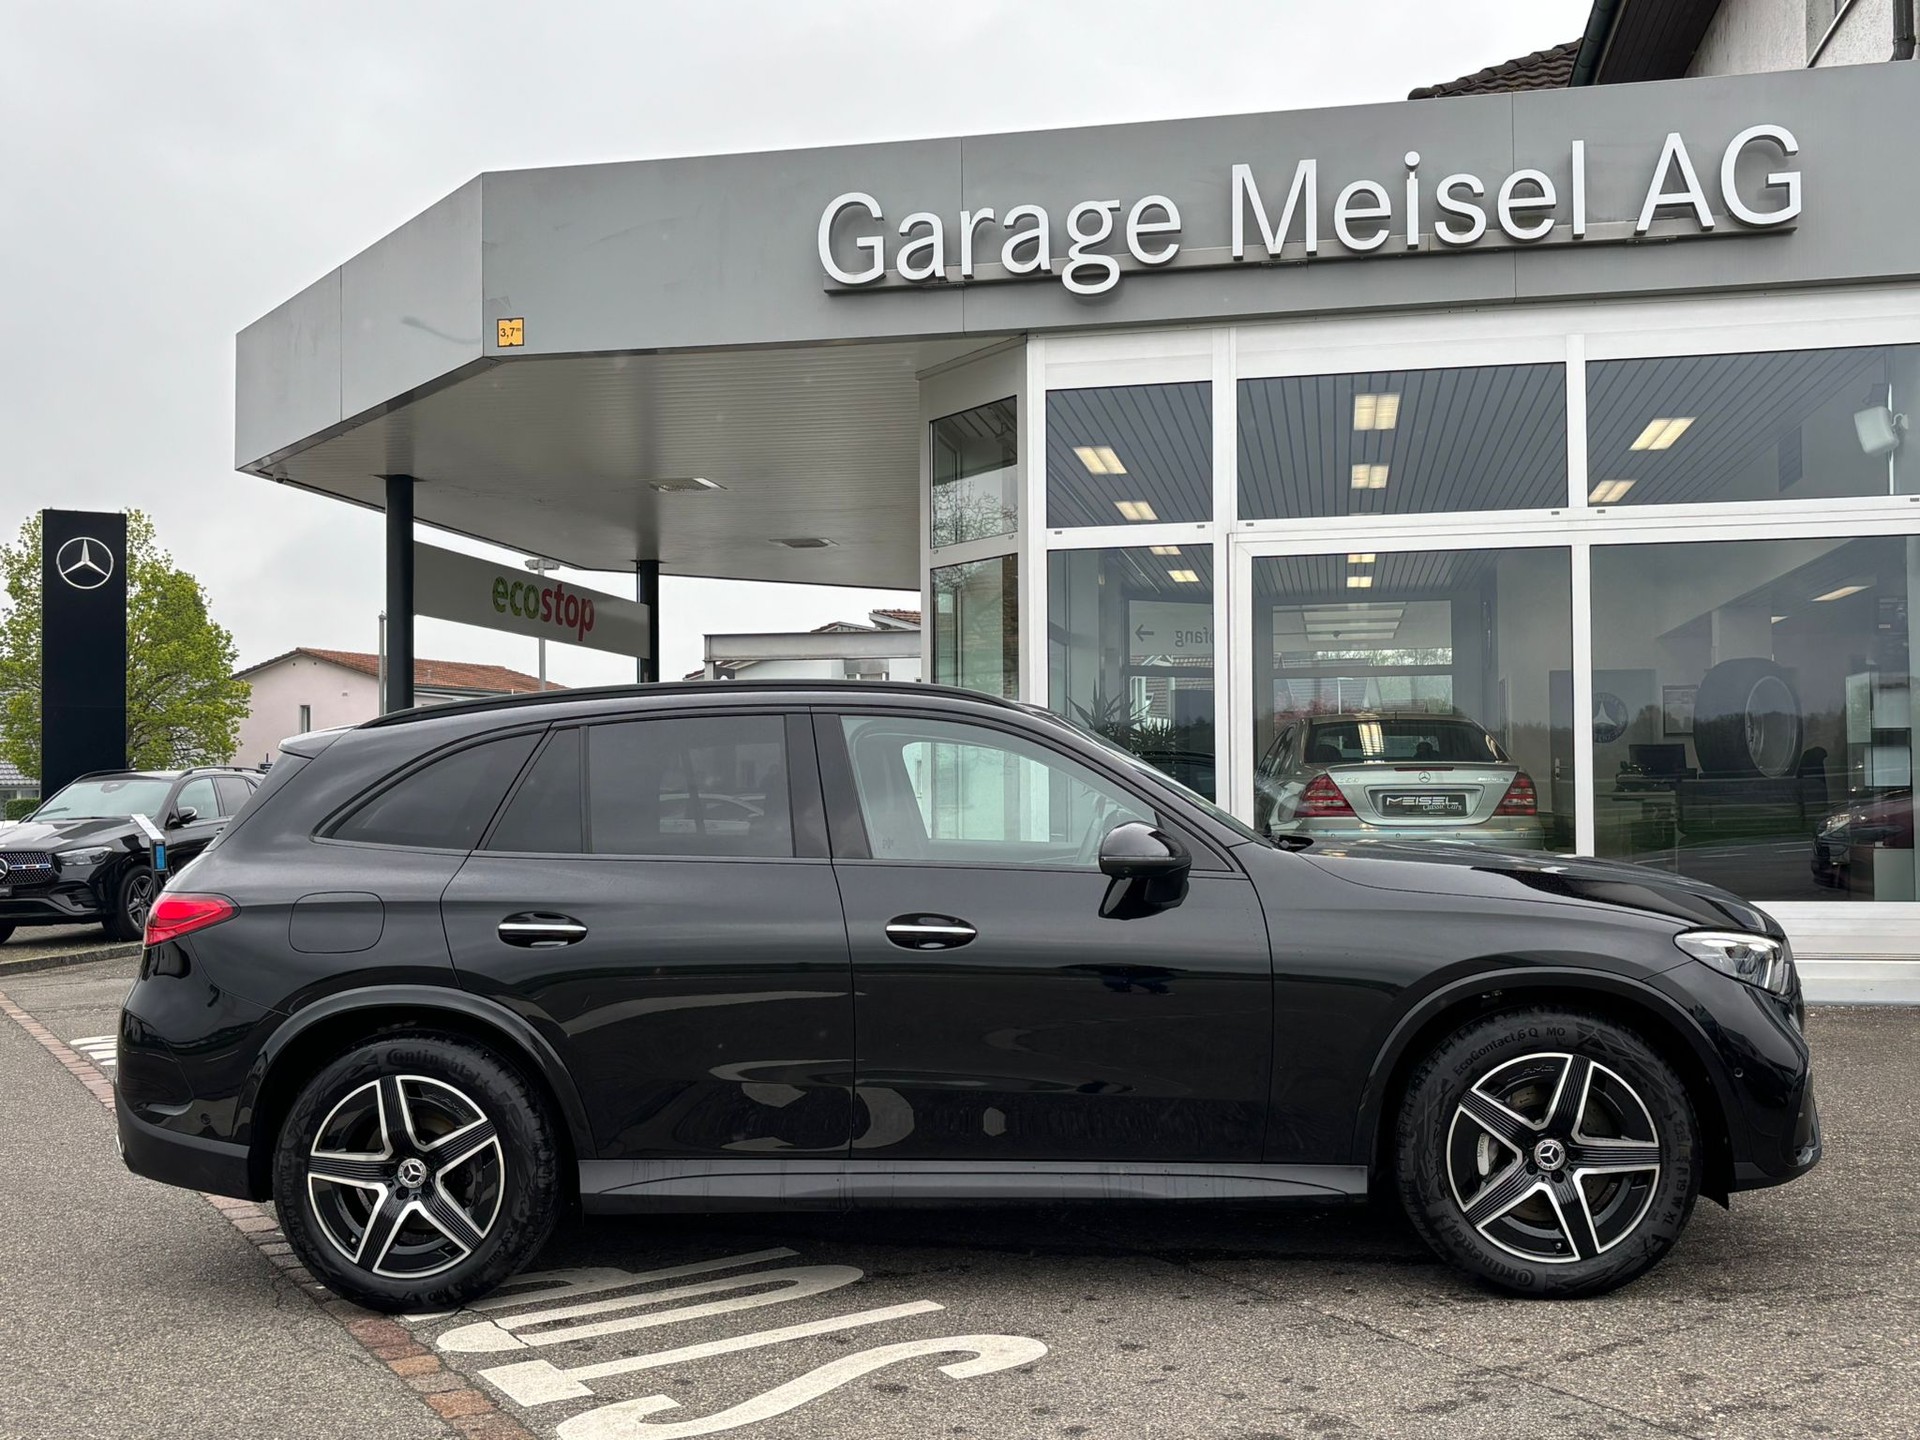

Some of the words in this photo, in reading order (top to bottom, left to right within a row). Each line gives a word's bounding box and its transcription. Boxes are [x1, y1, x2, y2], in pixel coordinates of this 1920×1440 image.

[818, 192, 1182, 295] Garage
[1231, 140, 1586, 261] Meisel
[1636, 124, 1801, 234] AG
[492, 577, 595, 642] ecostop
[1386, 796, 1459, 806] MEISEL
